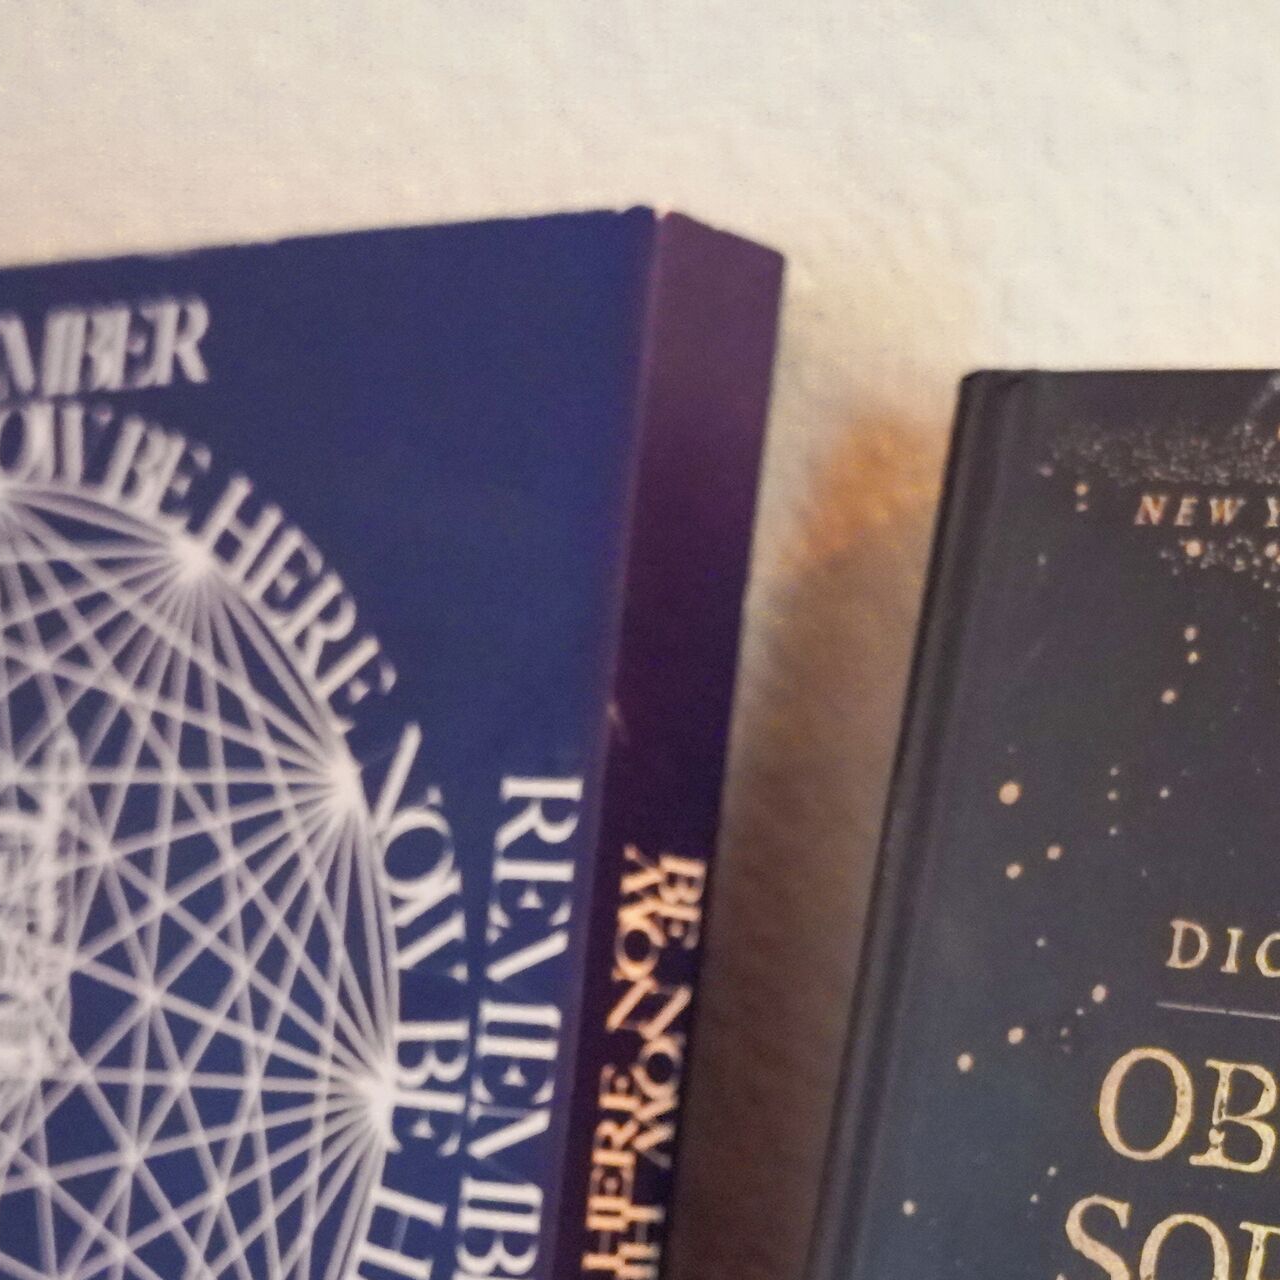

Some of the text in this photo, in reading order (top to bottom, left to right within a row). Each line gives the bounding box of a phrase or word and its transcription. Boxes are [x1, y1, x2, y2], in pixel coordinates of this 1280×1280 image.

[102, 412, 213, 526] BE
[1134, 494, 1245, 527] NEW
[196, 474, 398, 730] HERE
[358, 720, 470, 983] NOW
[388, 1017, 470, 1158] BE
